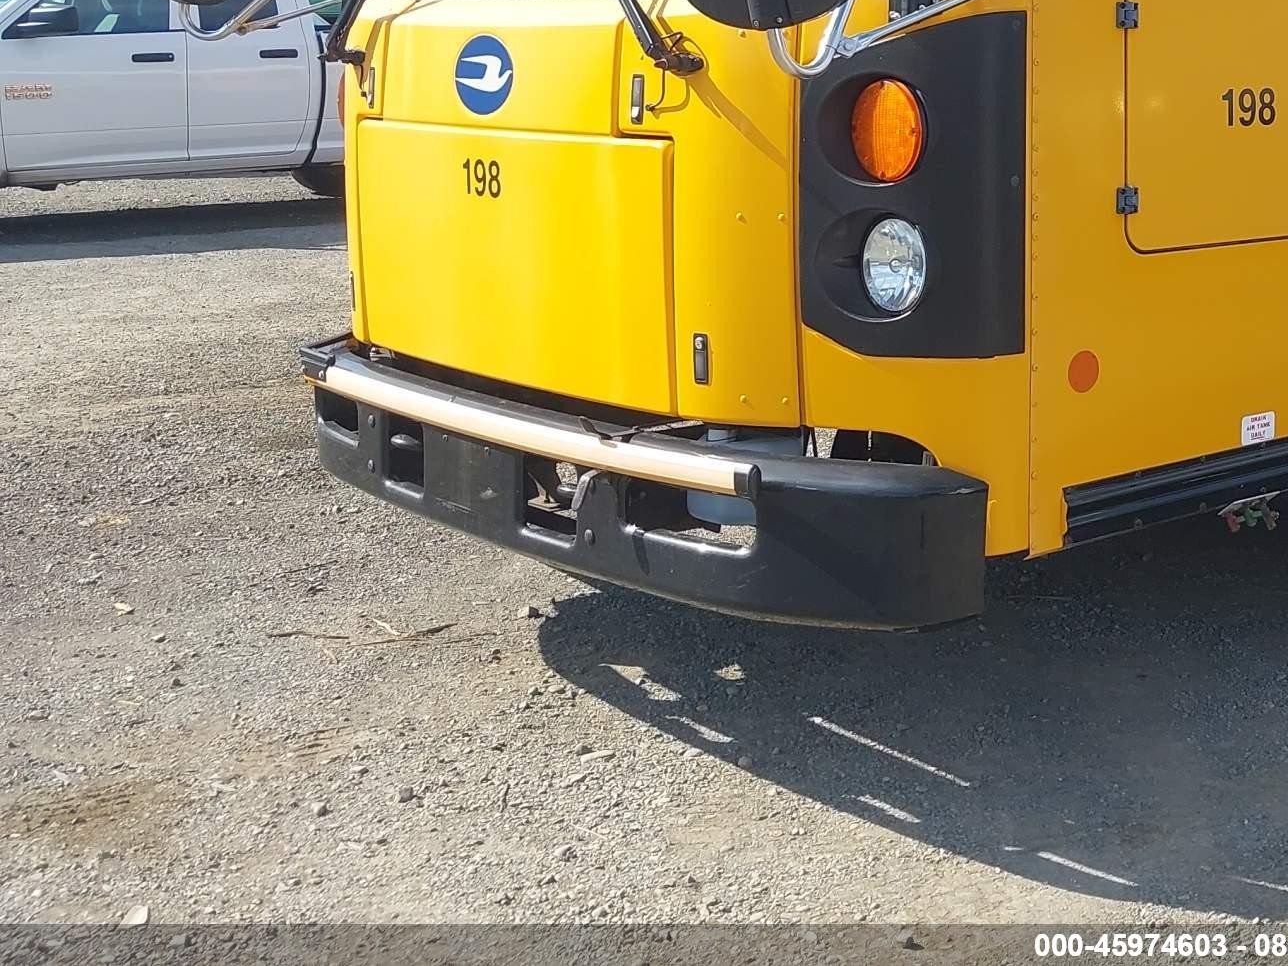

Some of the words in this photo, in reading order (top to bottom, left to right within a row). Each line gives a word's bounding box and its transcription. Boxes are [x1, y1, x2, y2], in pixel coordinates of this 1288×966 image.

[1221, 88, 1277, 127] 198
[462, 157, 502, 199] 198
[1250, 430, 1266, 438] DAILY
